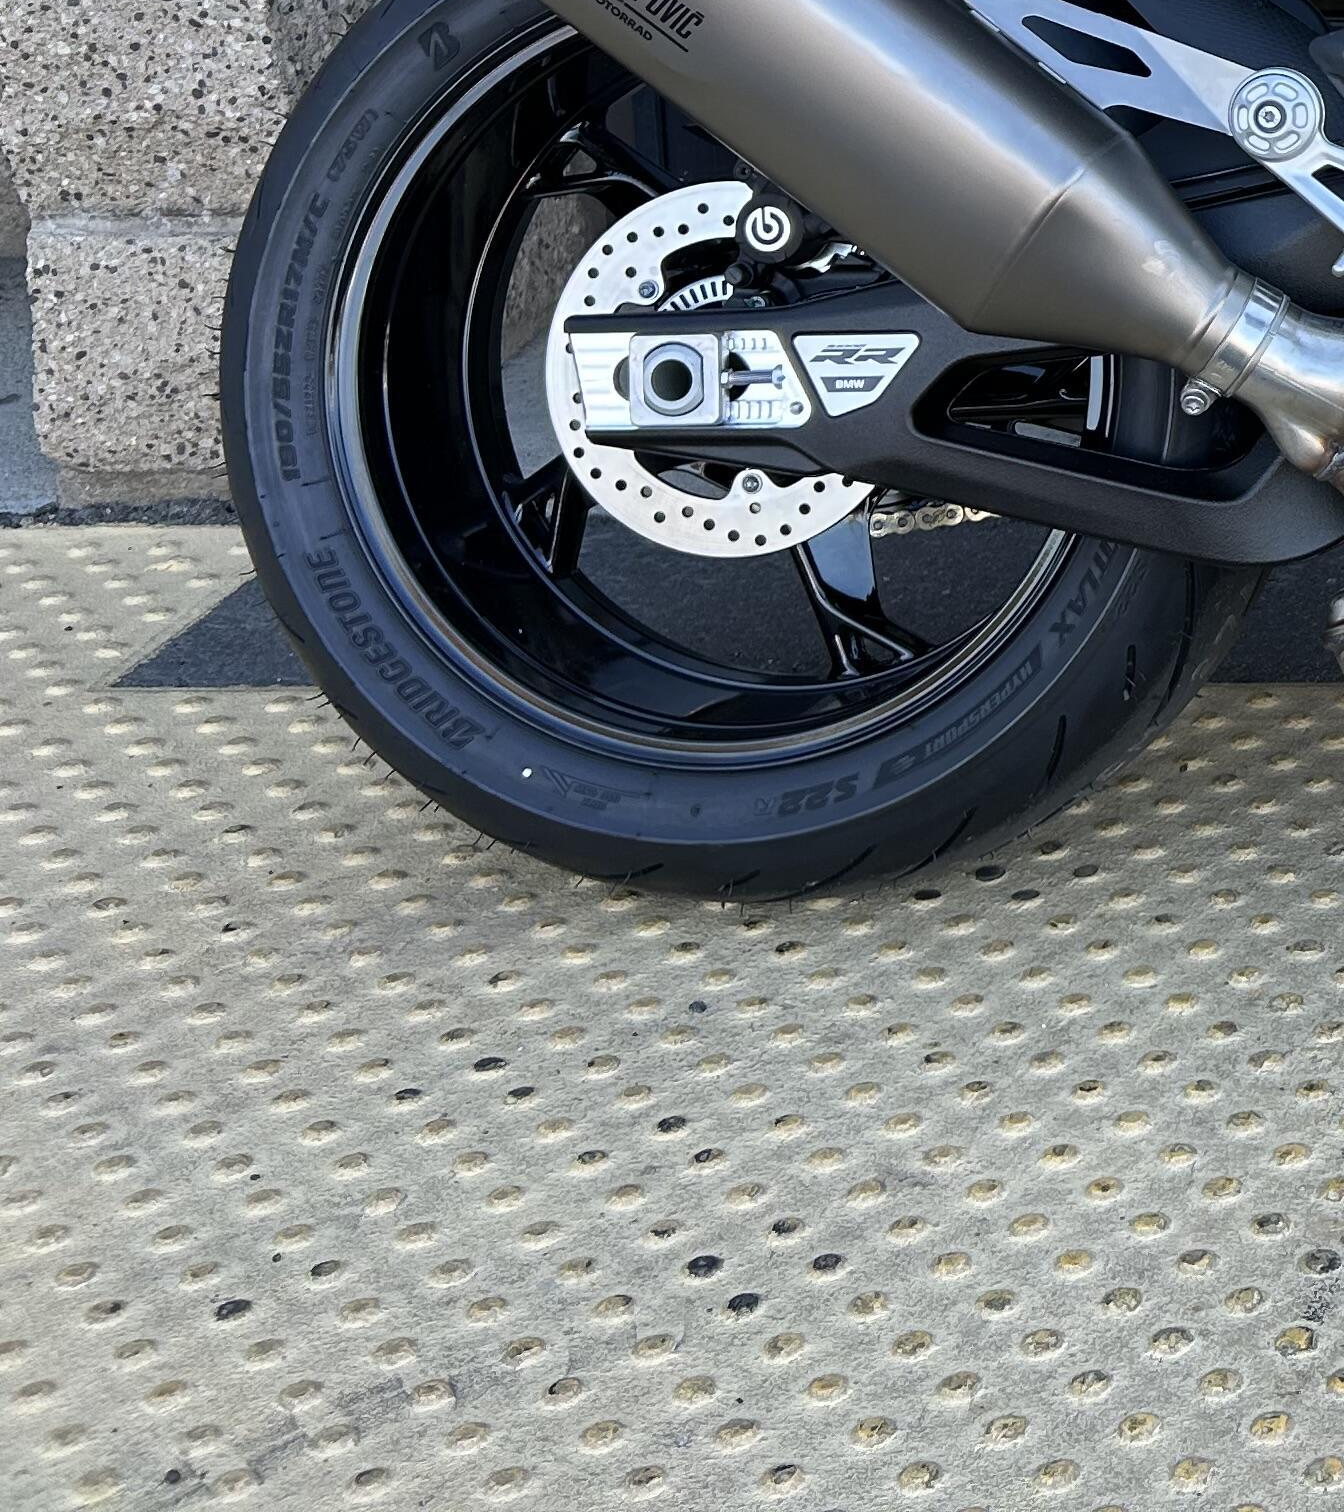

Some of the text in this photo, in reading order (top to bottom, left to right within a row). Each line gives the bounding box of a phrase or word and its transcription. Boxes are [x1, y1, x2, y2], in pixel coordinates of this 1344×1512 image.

[809, 346, 906, 365] RR
[835, 379, 865, 389] BMW
[305, 545, 486, 751] BRIDGESTONE
[922, 659, 1035, 758] HYPERSPORT
[775, 776, 862, 817] S22
